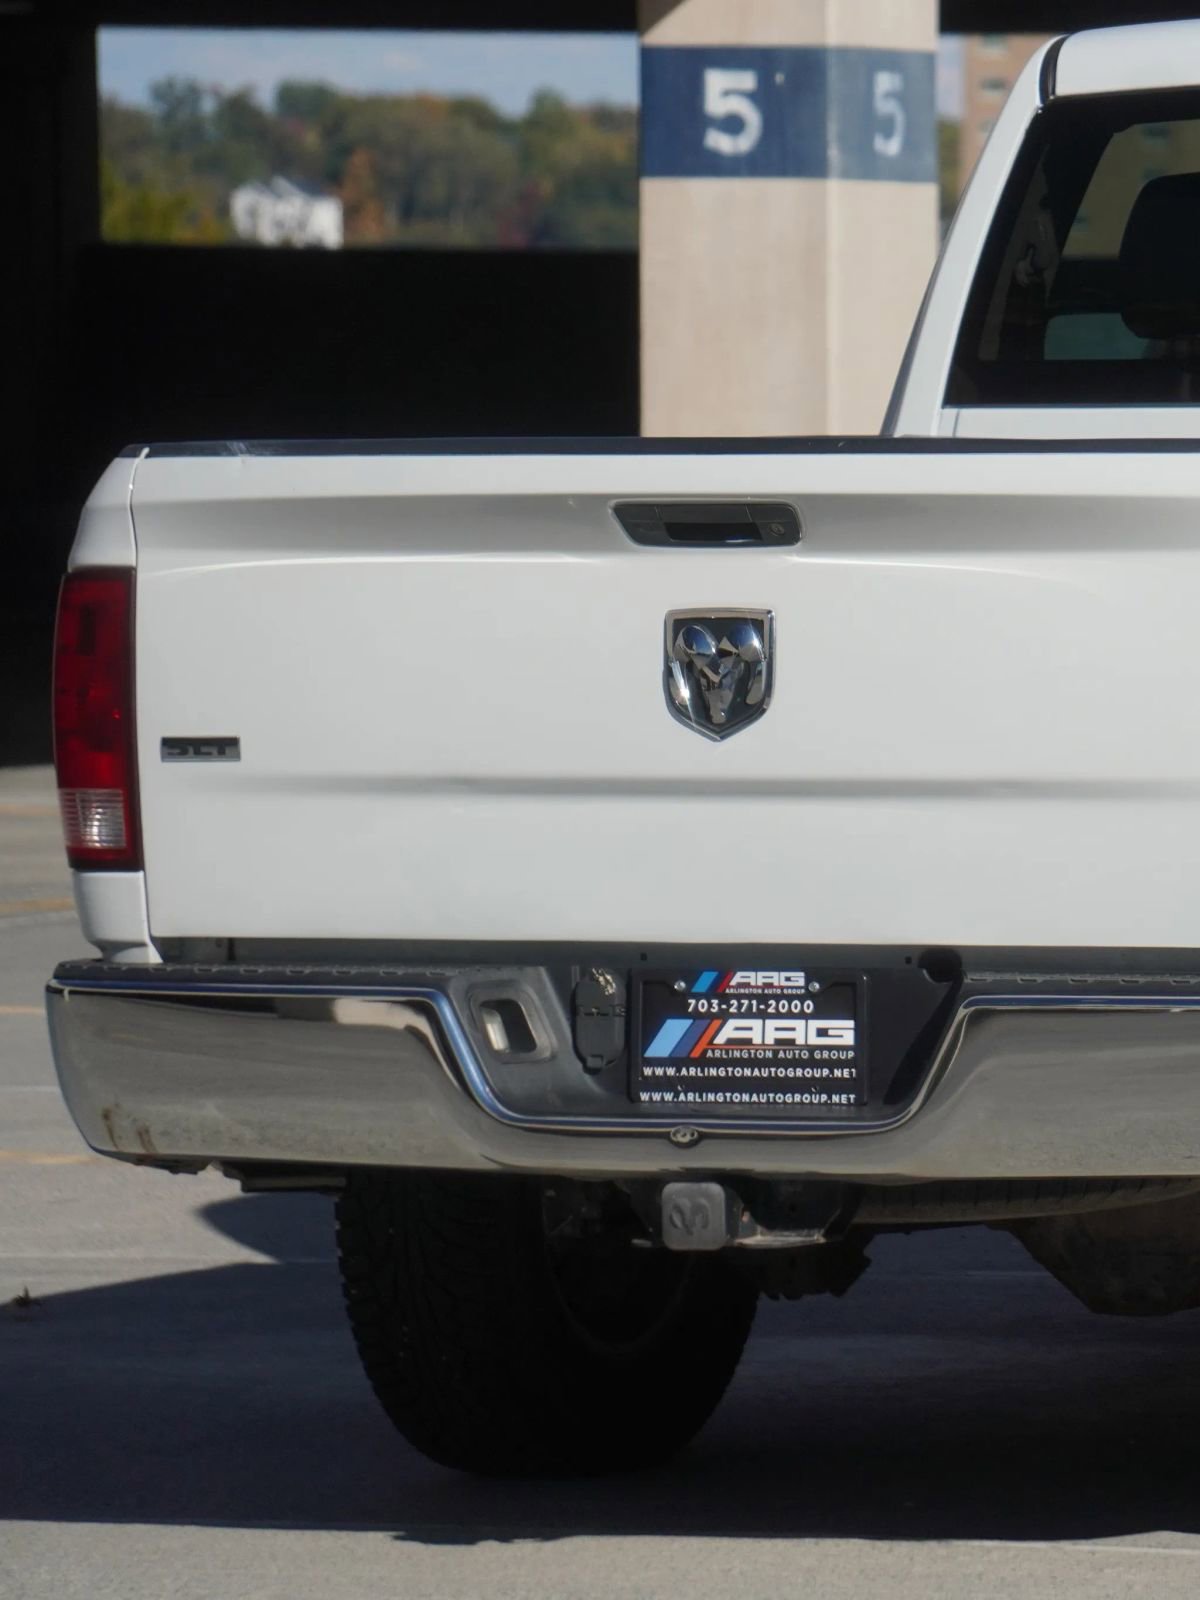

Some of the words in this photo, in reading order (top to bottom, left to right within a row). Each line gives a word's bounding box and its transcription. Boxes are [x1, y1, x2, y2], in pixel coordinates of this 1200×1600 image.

[703, 68, 763, 157] 5
[872, 71, 905, 157] 5
[728, 971, 805, 986] AAG
[687, 999, 814, 1013] 703-271-2000
[712, 1018, 855, 1045] AAG
[706, 1049, 773, 1058] ARLINGTON
[777, 1050, 809, 1059] AUTO
[813, 1050, 855, 1059] GROUP
[639, 1091, 856, 1104] WWW.ARLINGTONAUTOGROUP.NET
